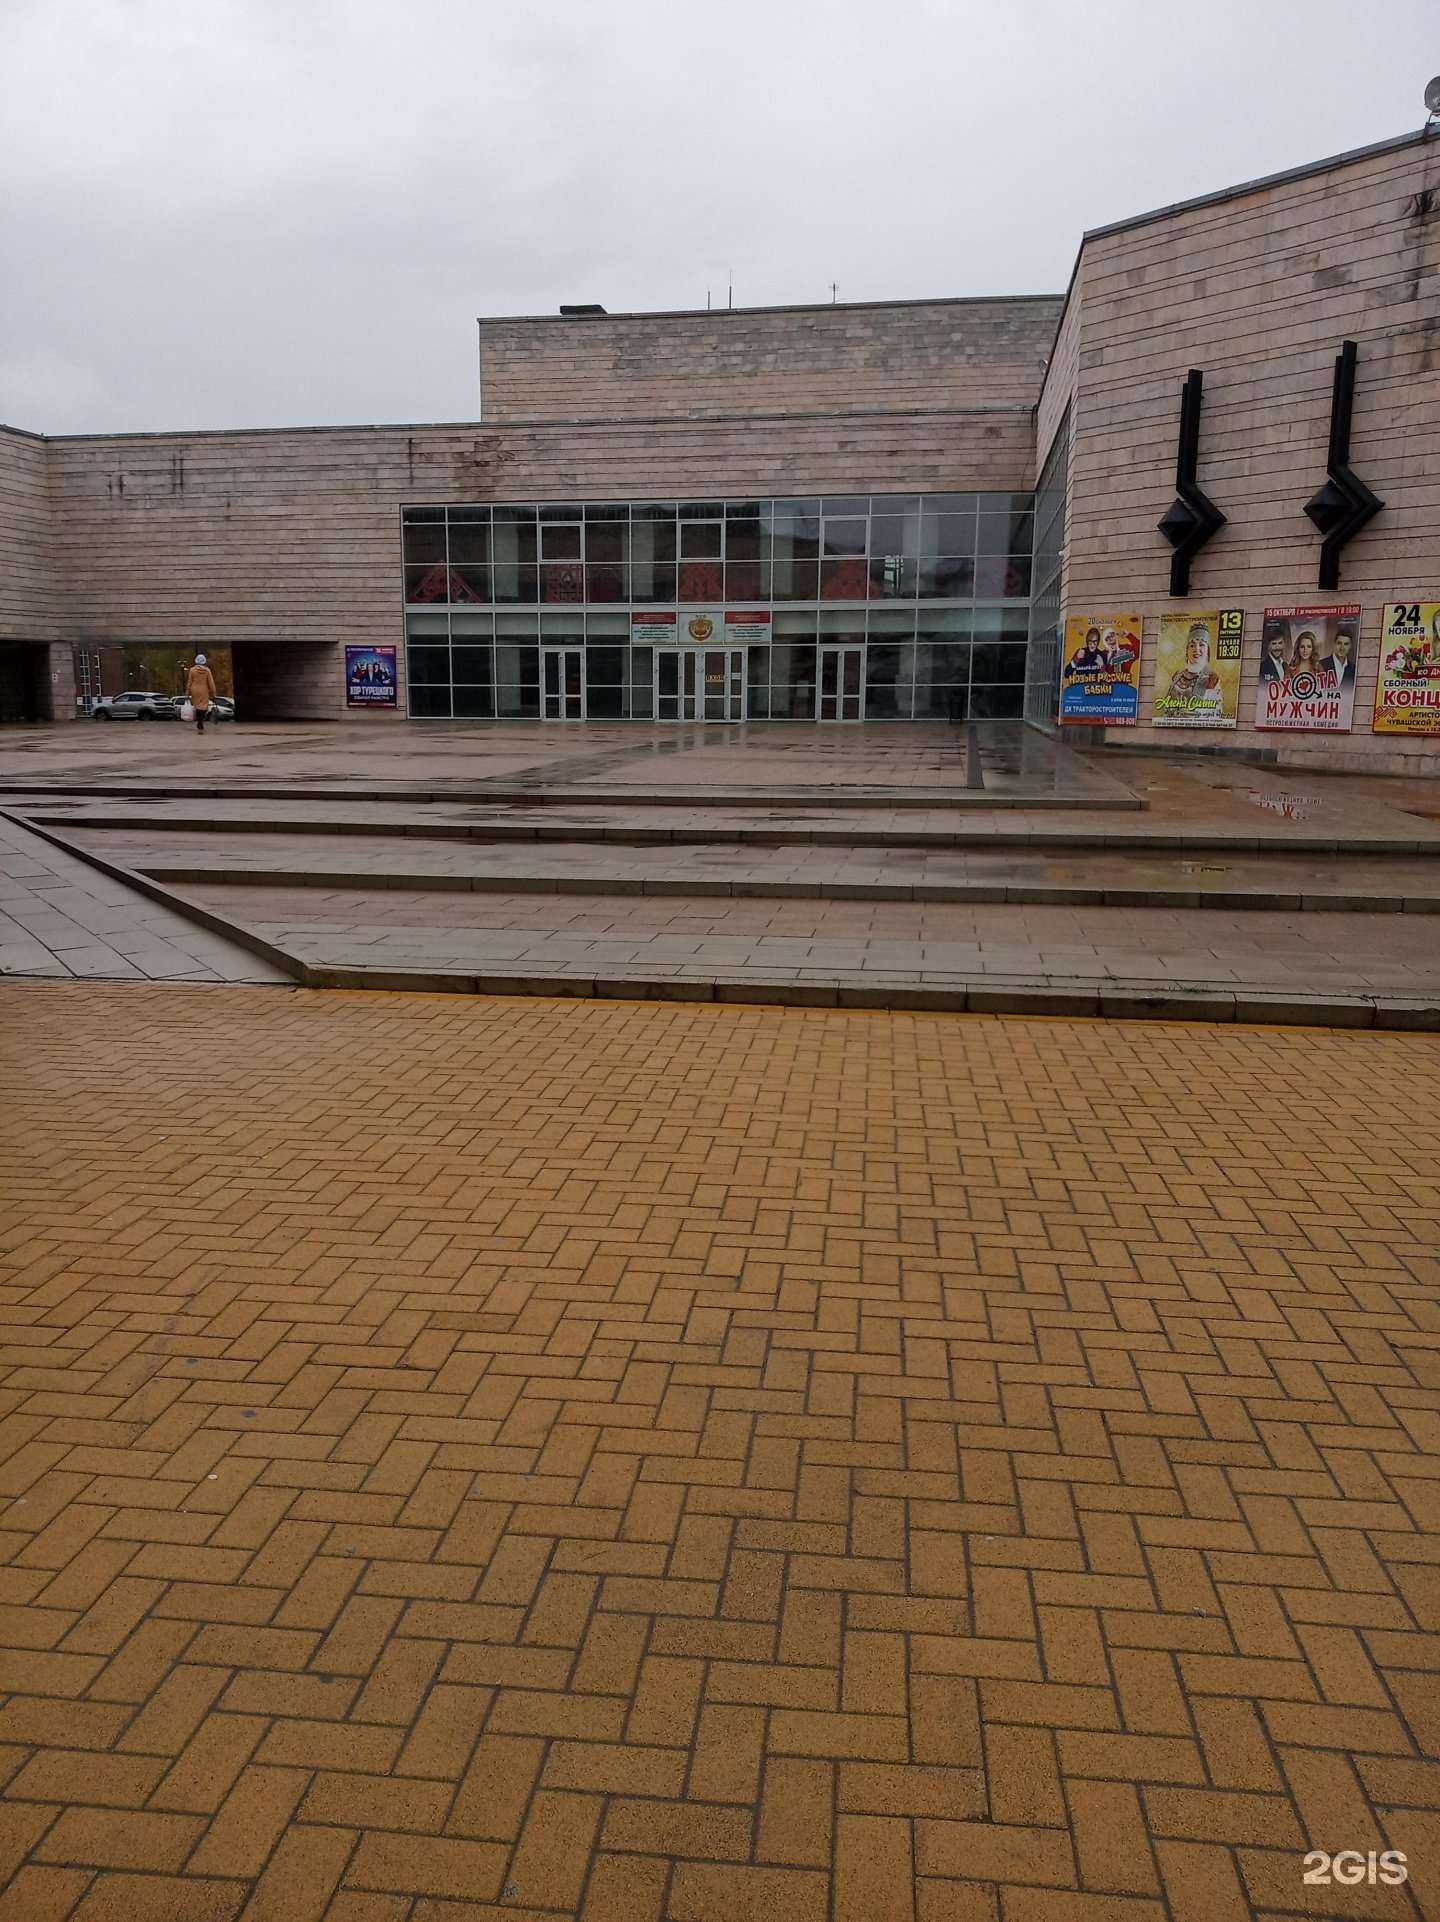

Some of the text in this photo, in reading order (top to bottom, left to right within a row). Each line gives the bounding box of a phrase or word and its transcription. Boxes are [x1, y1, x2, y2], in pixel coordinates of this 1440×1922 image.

[1221, 612, 1241, 629] 13
[1392, 604, 1421, 627] 24
[1388, 627, 1425, 635] НОЯБРЯ
[1219, 645, 1239, 656] 18:30
[1384, 679, 1427, 687] СБОРНЫЙ
[1084, 685, 1112, 695] БАБКИ
[1327, 691, 1341, 699] НА
[1266, 701, 1339, 719] МУЖЧИН
